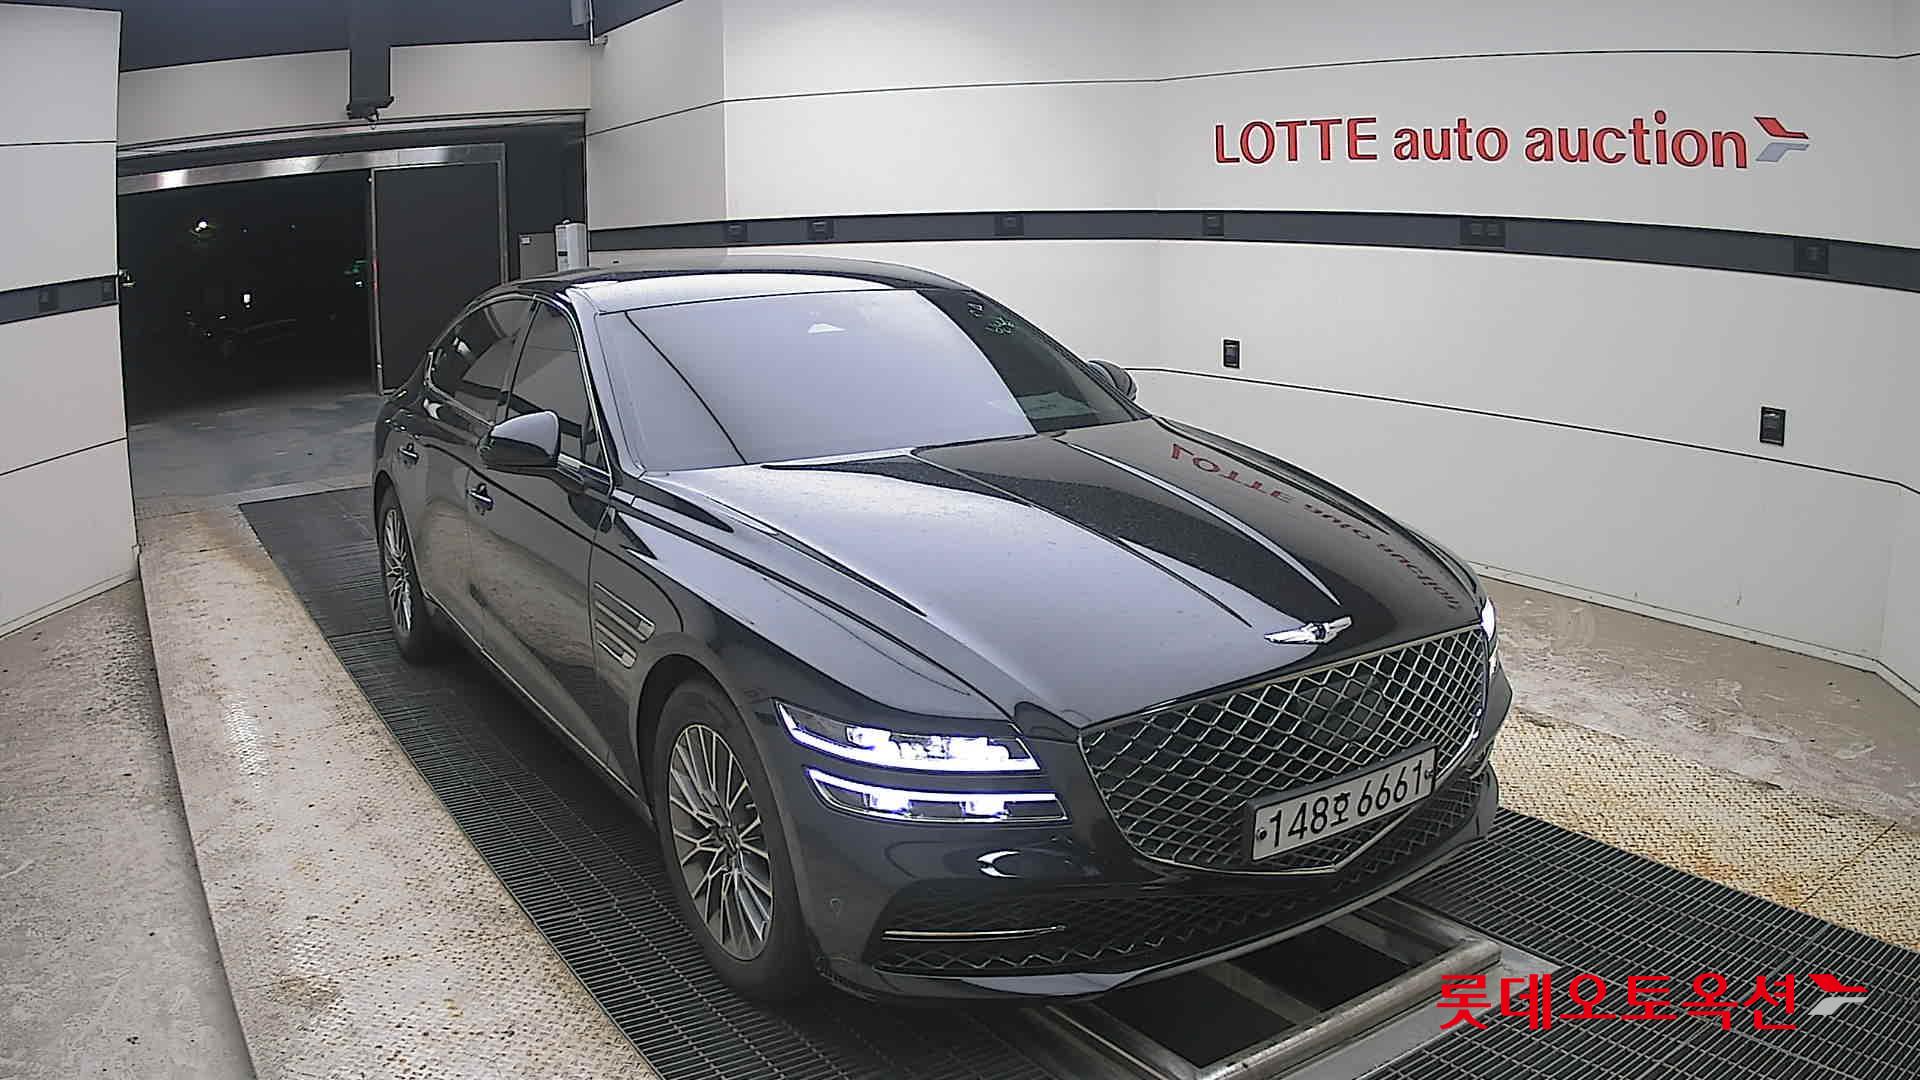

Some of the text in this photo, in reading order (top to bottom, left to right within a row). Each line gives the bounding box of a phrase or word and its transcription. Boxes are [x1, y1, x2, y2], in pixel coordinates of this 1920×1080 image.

[1214, 110, 1749, 168] LOTTE auto auction
